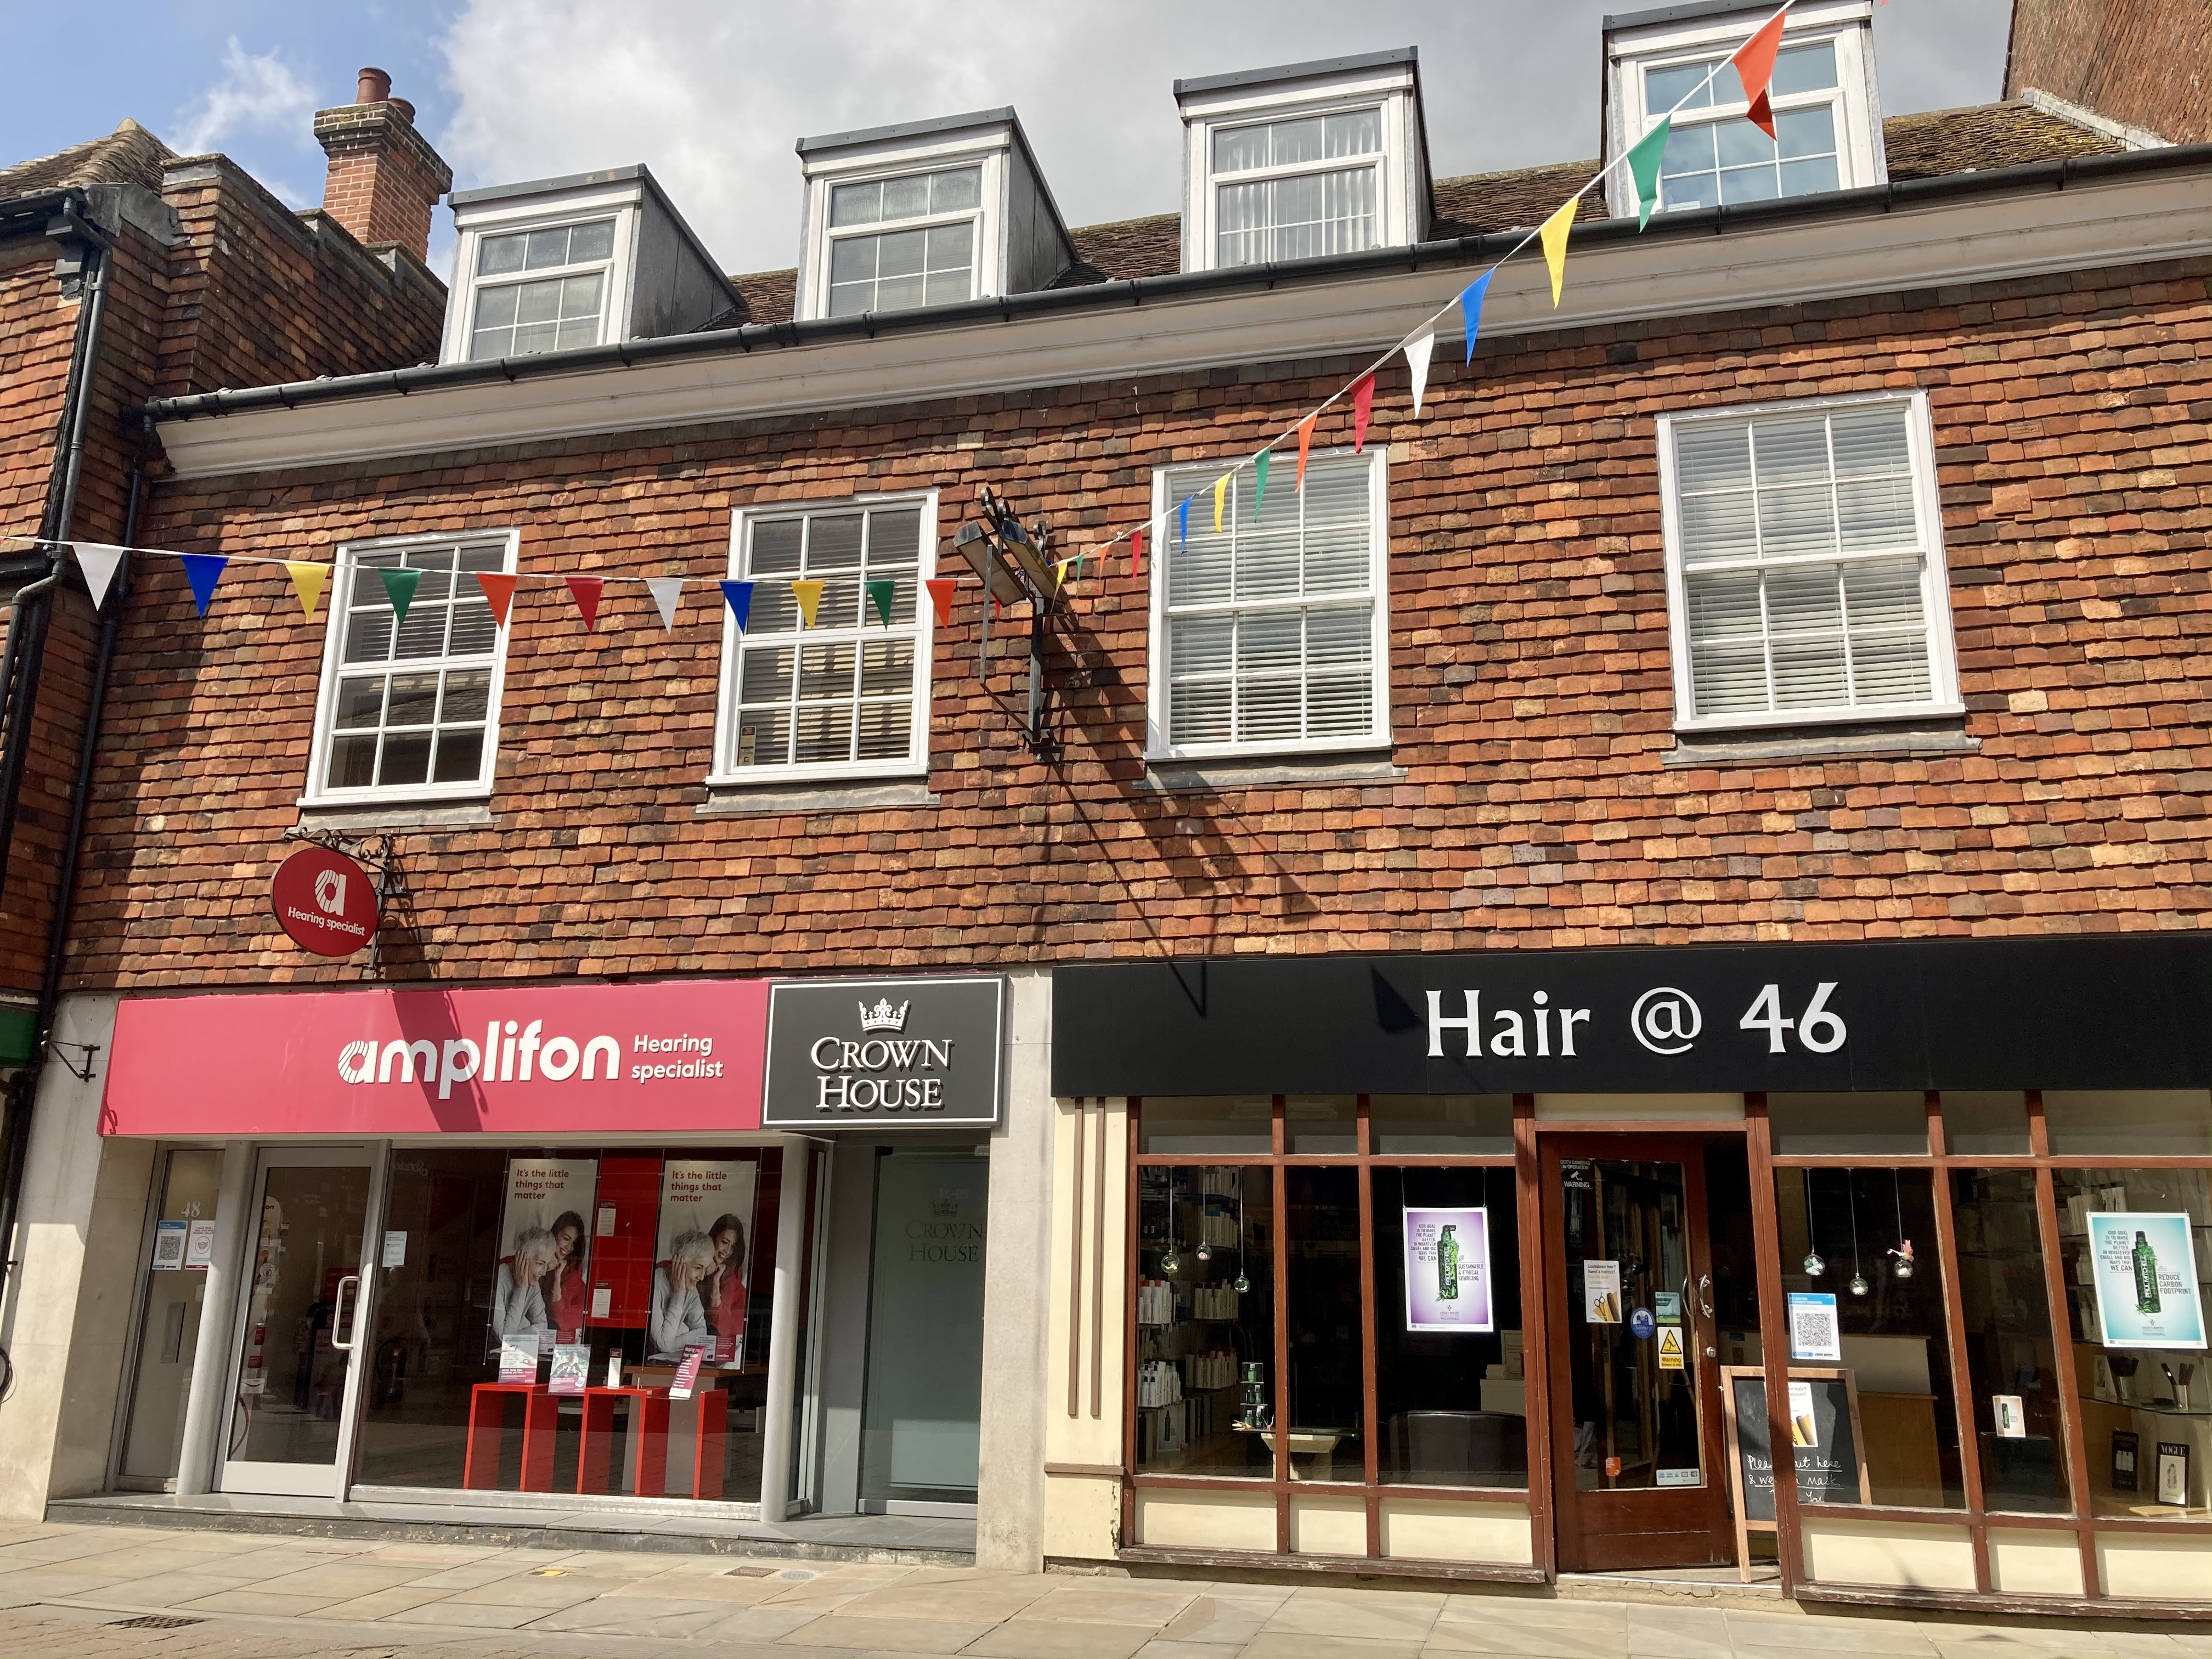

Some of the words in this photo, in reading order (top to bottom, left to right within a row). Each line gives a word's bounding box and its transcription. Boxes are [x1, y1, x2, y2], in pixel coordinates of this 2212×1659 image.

[288, 906, 325, 928] Hearing
[326, 919, 365, 936] specialist
[1425, 989, 1591, 1058] Hair
[1630, 987, 1702, 1054] @
[1740, 982, 1847, 1053] 46
[633, 1034, 714, 1057] Hearing
[811, 1036, 952, 1069] CROWN
[338, 1019, 620, 1099] amplifon
[631, 1059, 724, 1084] specialist
[815, 1075, 943, 1108] HOUSE
[517, 1169, 528, 1177] It's
[549, 1169, 569, 1178] little
[672, 1171, 685, 1179] It's
[687, 1171, 703, 1180] the
[706, 1171, 727, 1180] little
[516, 1181, 543, 1189] things
[545, 1181, 564, 1189] that
[671, 1183, 699, 1192] things
[702, 1183, 722, 1192] that
[670, 1194, 703, 1202] matter
[180, 1200, 201, 1217] 48
[906, 1220, 983, 1239] CROWN
[908, 1243, 979, 1261] HOUSE
[2161, 1444, 2185, 1456] VOGUE
[1747, 1454, 1773, 1469] Plea
[1795, 1456, 1810, 1468] ait
[1817, 1455, 1841, 1468] here
[1748, 1474, 1756, 1484] &
